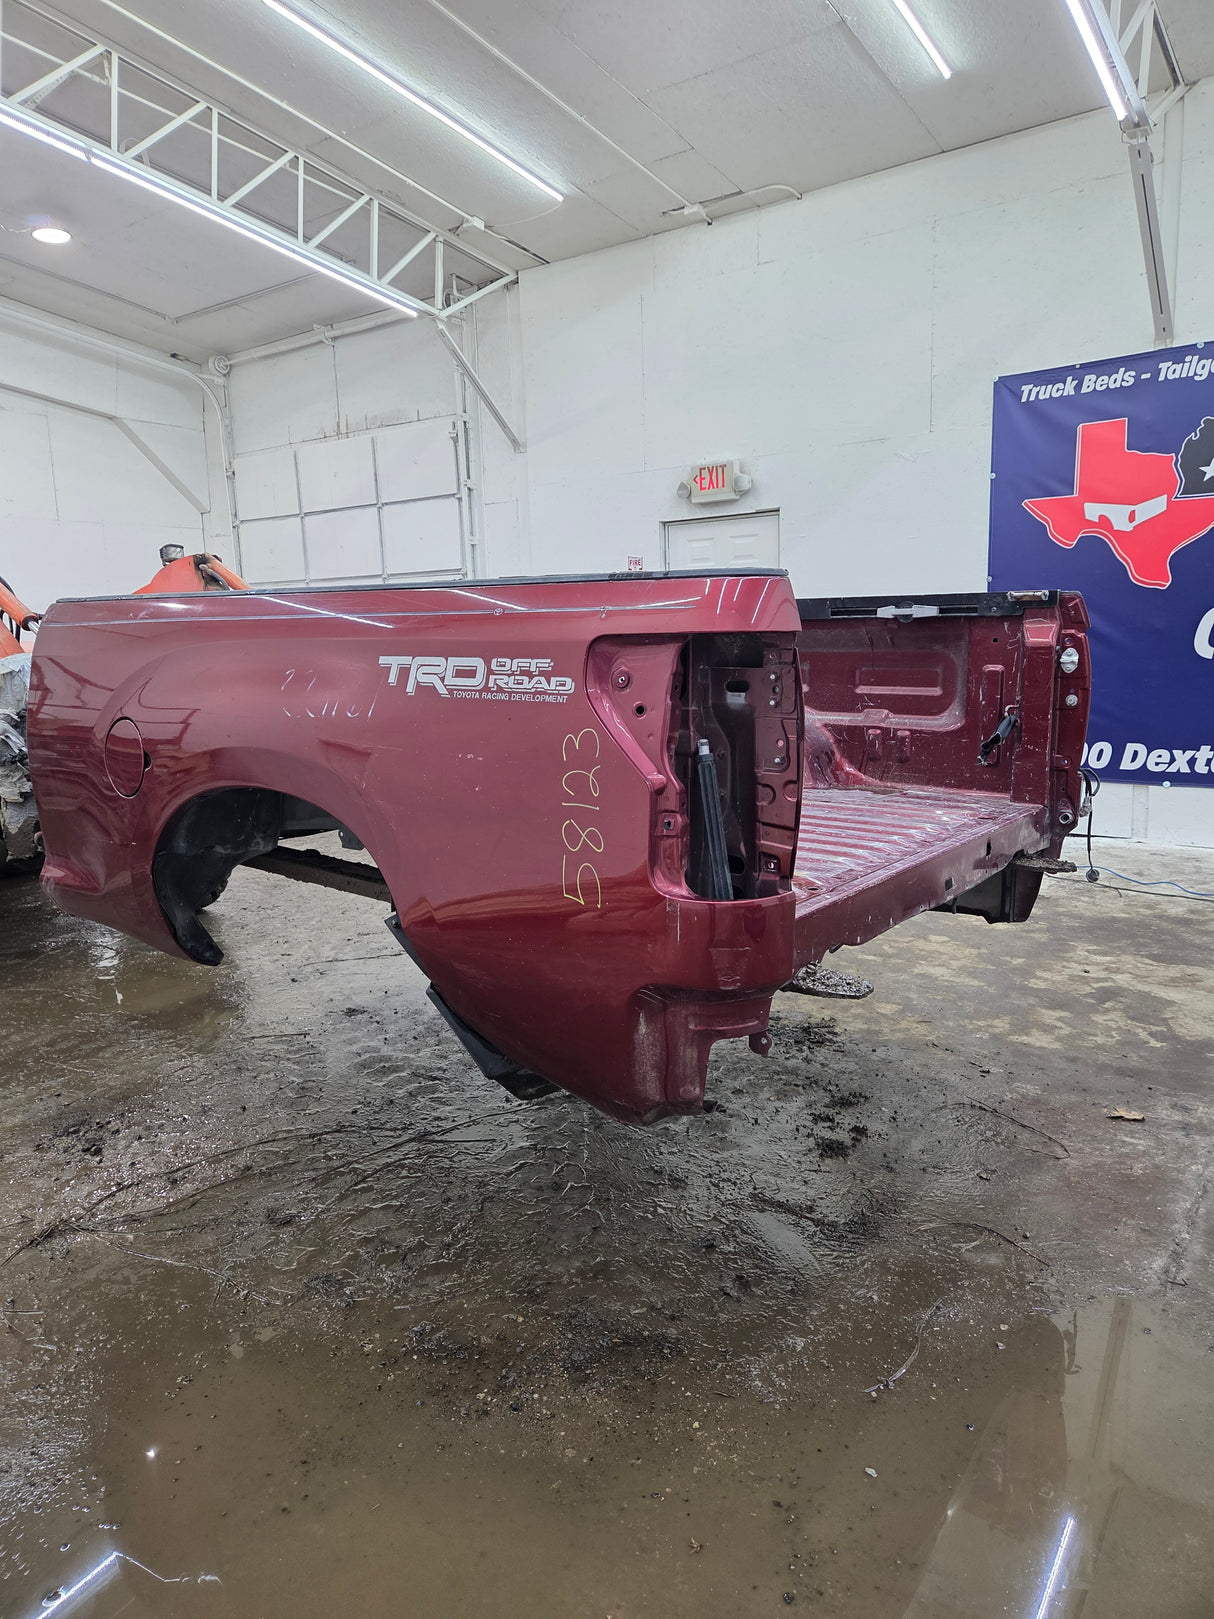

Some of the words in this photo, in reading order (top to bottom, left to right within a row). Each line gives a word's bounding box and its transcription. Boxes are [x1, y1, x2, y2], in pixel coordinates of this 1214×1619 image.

[1020, 376, 1079, 403] Truck
[1080, 367, 1136, 394] Beds
[1158, 355, 1214, 382] Tailg
[699, 464, 727, 491] EXIT
[629, 559, 642, 567] FIRE
[378, 655, 488, 698] TRD
[490, 657, 554, 675] OFF
[488, 674, 576, 694] ROAD
[452, 690, 480, 699] TOYOTA
[481, 691, 509, 701] RACING
[511, 693, 568, 704] DEVELOPMENT
[1119, 742, 1214, 774] Dext
[562, 728, 604, 908] 58123
